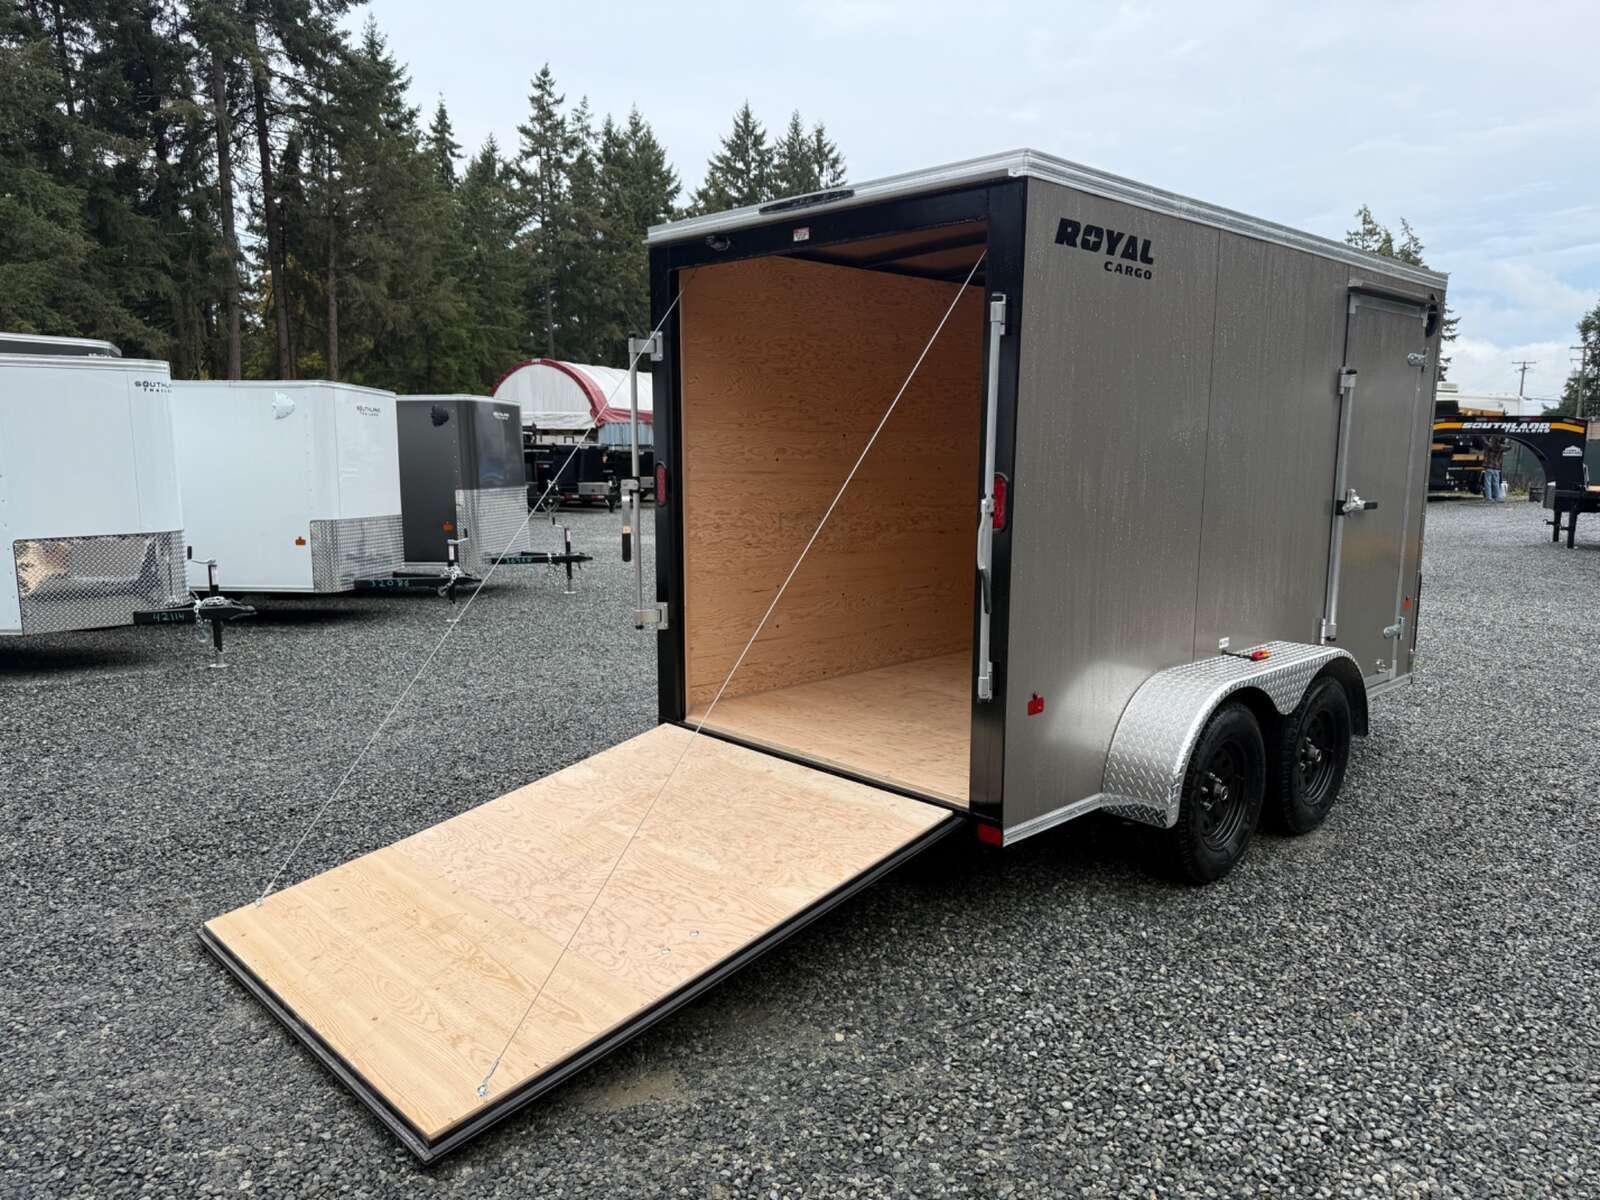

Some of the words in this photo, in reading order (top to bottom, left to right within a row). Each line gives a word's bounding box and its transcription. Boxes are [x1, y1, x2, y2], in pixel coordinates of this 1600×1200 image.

[1054, 217, 1154, 265] ROYAL
[1103, 261, 1153, 280] CARGO
[1462, 422, 1551, 430] SOUTHLAND
